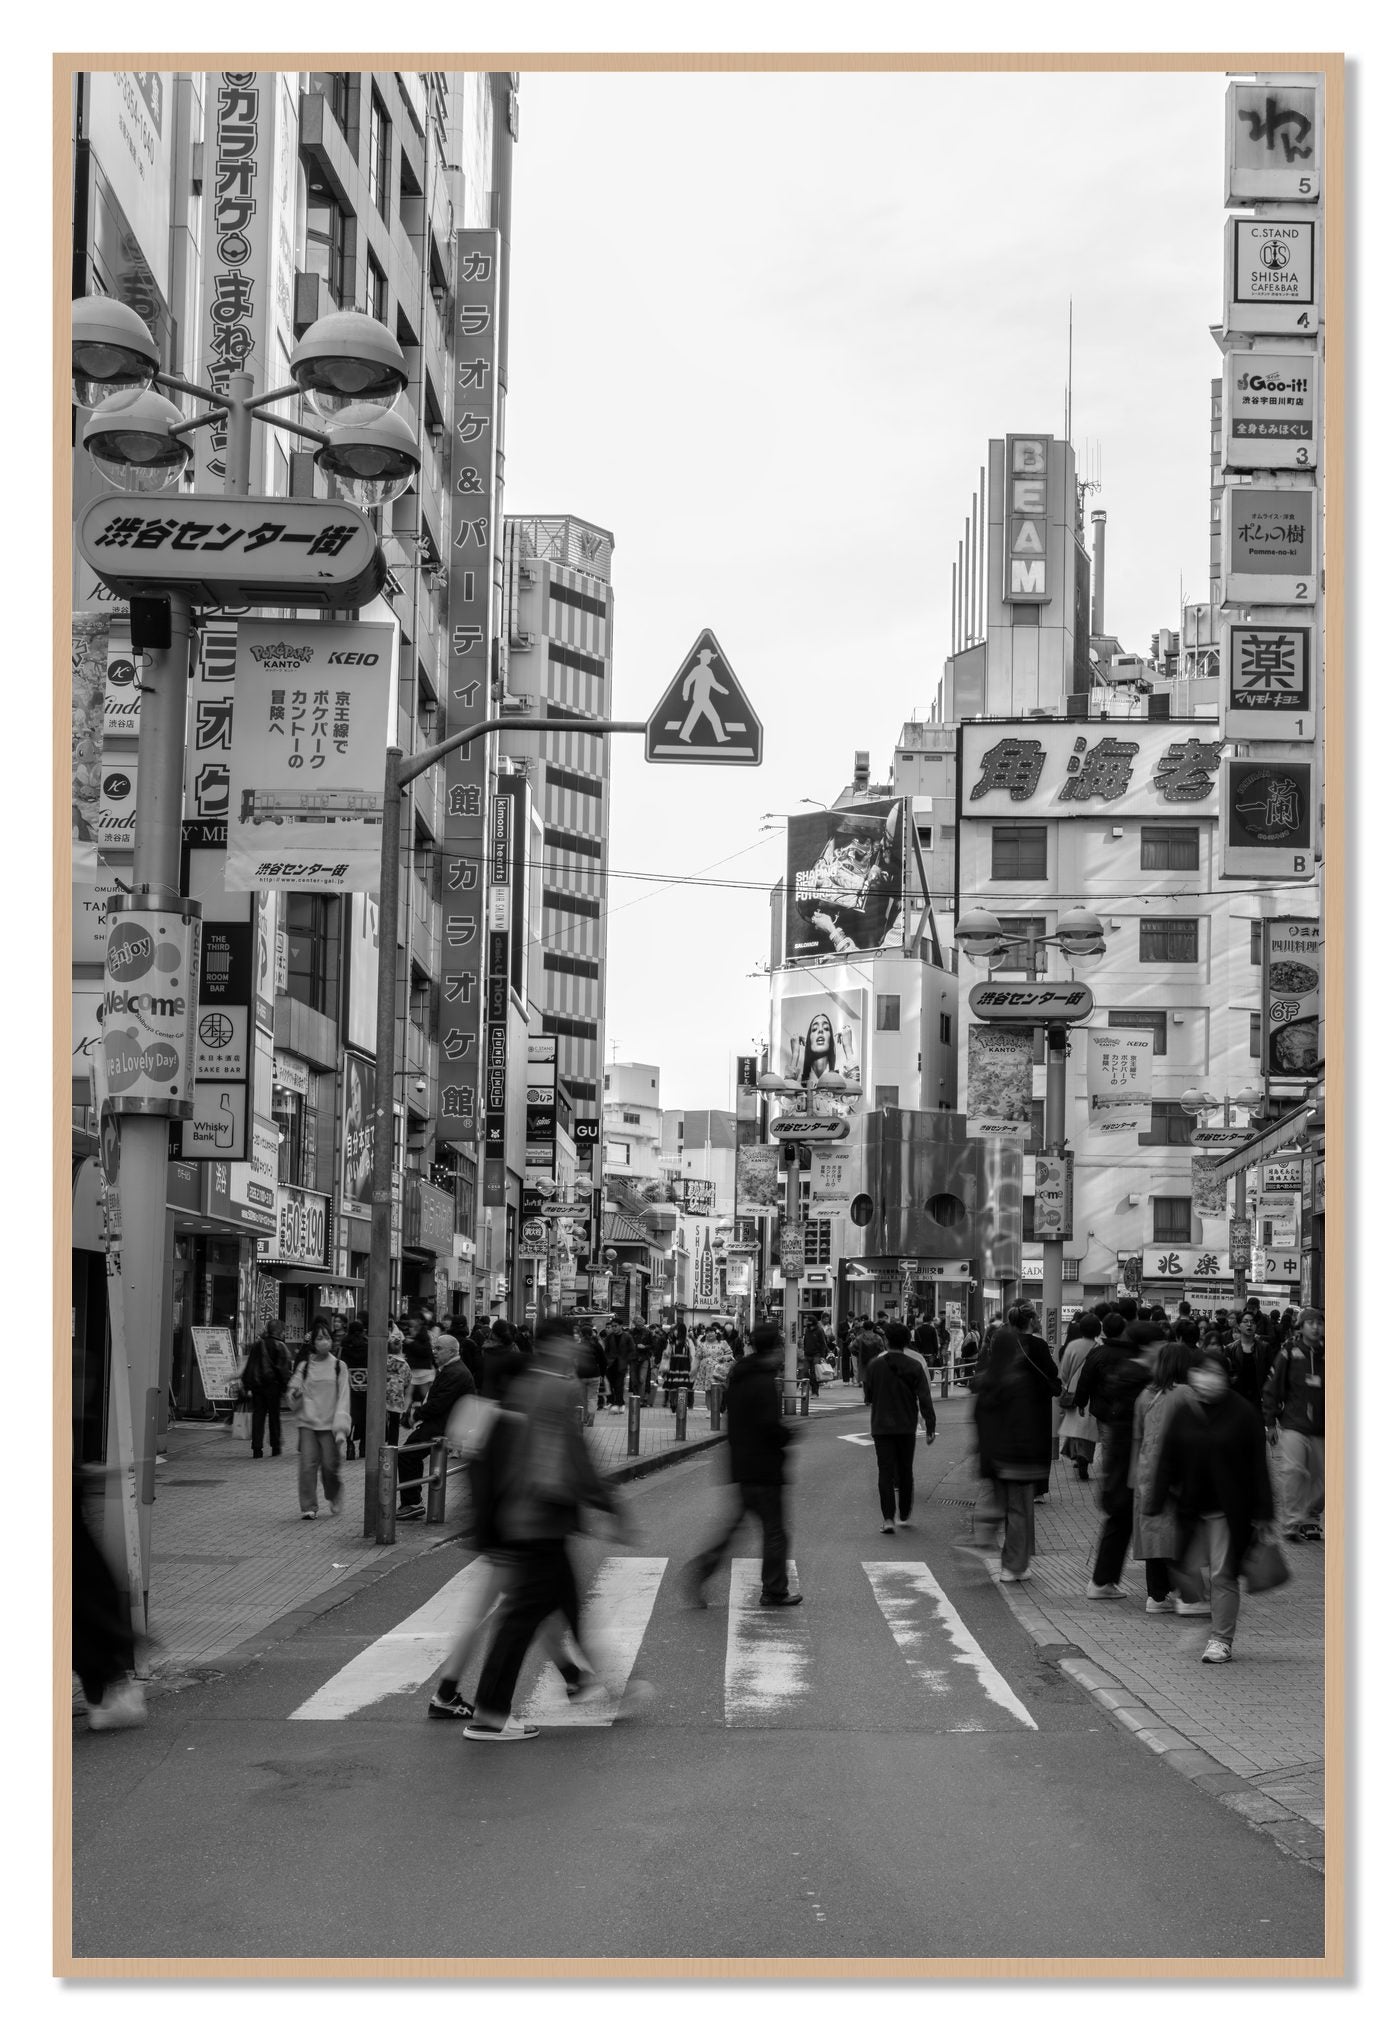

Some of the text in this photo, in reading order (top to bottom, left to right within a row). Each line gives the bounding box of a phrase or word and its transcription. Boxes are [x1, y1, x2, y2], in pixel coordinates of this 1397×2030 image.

[216, 87, 258, 234] カラオケ
[1299, 178, 1311, 194] 5
[1251, 228, 1299, 238] C.STAND
[1251, 271, 1298, 282] SHISHA
[1251, 283, 1298, 292] CAFE&BAR
[1297, 312, 1310, 328] 4
[1249, 375, 1307, 392] Goo-it!
[1241, 396, 1304, 406] 渋谷宇田川町店
[1237, 423, 1309, 435] 全身もみほぐし
[1296, 447, 1308, 465] 3
[1011, 439, 1047, 593] BEAM
[95, 516, 360, 557] 渋谷センター街
[1295, 582, 1308, 599] 2
[263, 660, 300, 669] KANTO
[327, 651, 379, 666] KEIO
[1241, 634, 1295, 688] 薬
[1235, 691, 1301, 707] マツモトキヨシ
[268, 690, 286, 736] 冒険へ
[108, 719, 135, 729] 渋谷店
[288, 690, 307, 769] カントーの
[310, 690, 329, 769] ポケパーク
[333, 691, 351, 754] 京王線で
[1294, 719, 1304, 735] 1
[970, 737, 1225, 801] 角海老
[496, 800, 507, 838] kimono
[104, 833, 131, 843] 渋谷店
[255, 862, 349, 877] 渋谷センター街
[1294, 855, 1306, 873] B
[211, 935, 227, 943] THE
[1271, 939, 1319, 953] 四川料理
[107, 936, 152, 975] Enjoy
[206, 943, 231, 952] THIRD
[206, 973, 229, 981] ROOM
[210, 985, 225, 993] BAR
[104, 989, 186, 1017] Welcome
[976, 991, 1086, 1006] 渋谷センター街
[1269, 1001, 1300, 1022] 6F
[122, 1051, 154, 1073] Lovely
[156, 1052, 177, 1068] Day!
[193, 1122, 229, 1133] Whisky
[576, 1125, 598, 1136] GU
[193, 1131, 214, 1141] Bank
[286, 1201, 300, 1254] 50
[306, 1206, 324, 1257] 190
[1157, 1252, 1220, 1275] 兆楽
[703, 1251, 712, 1295] BEER
